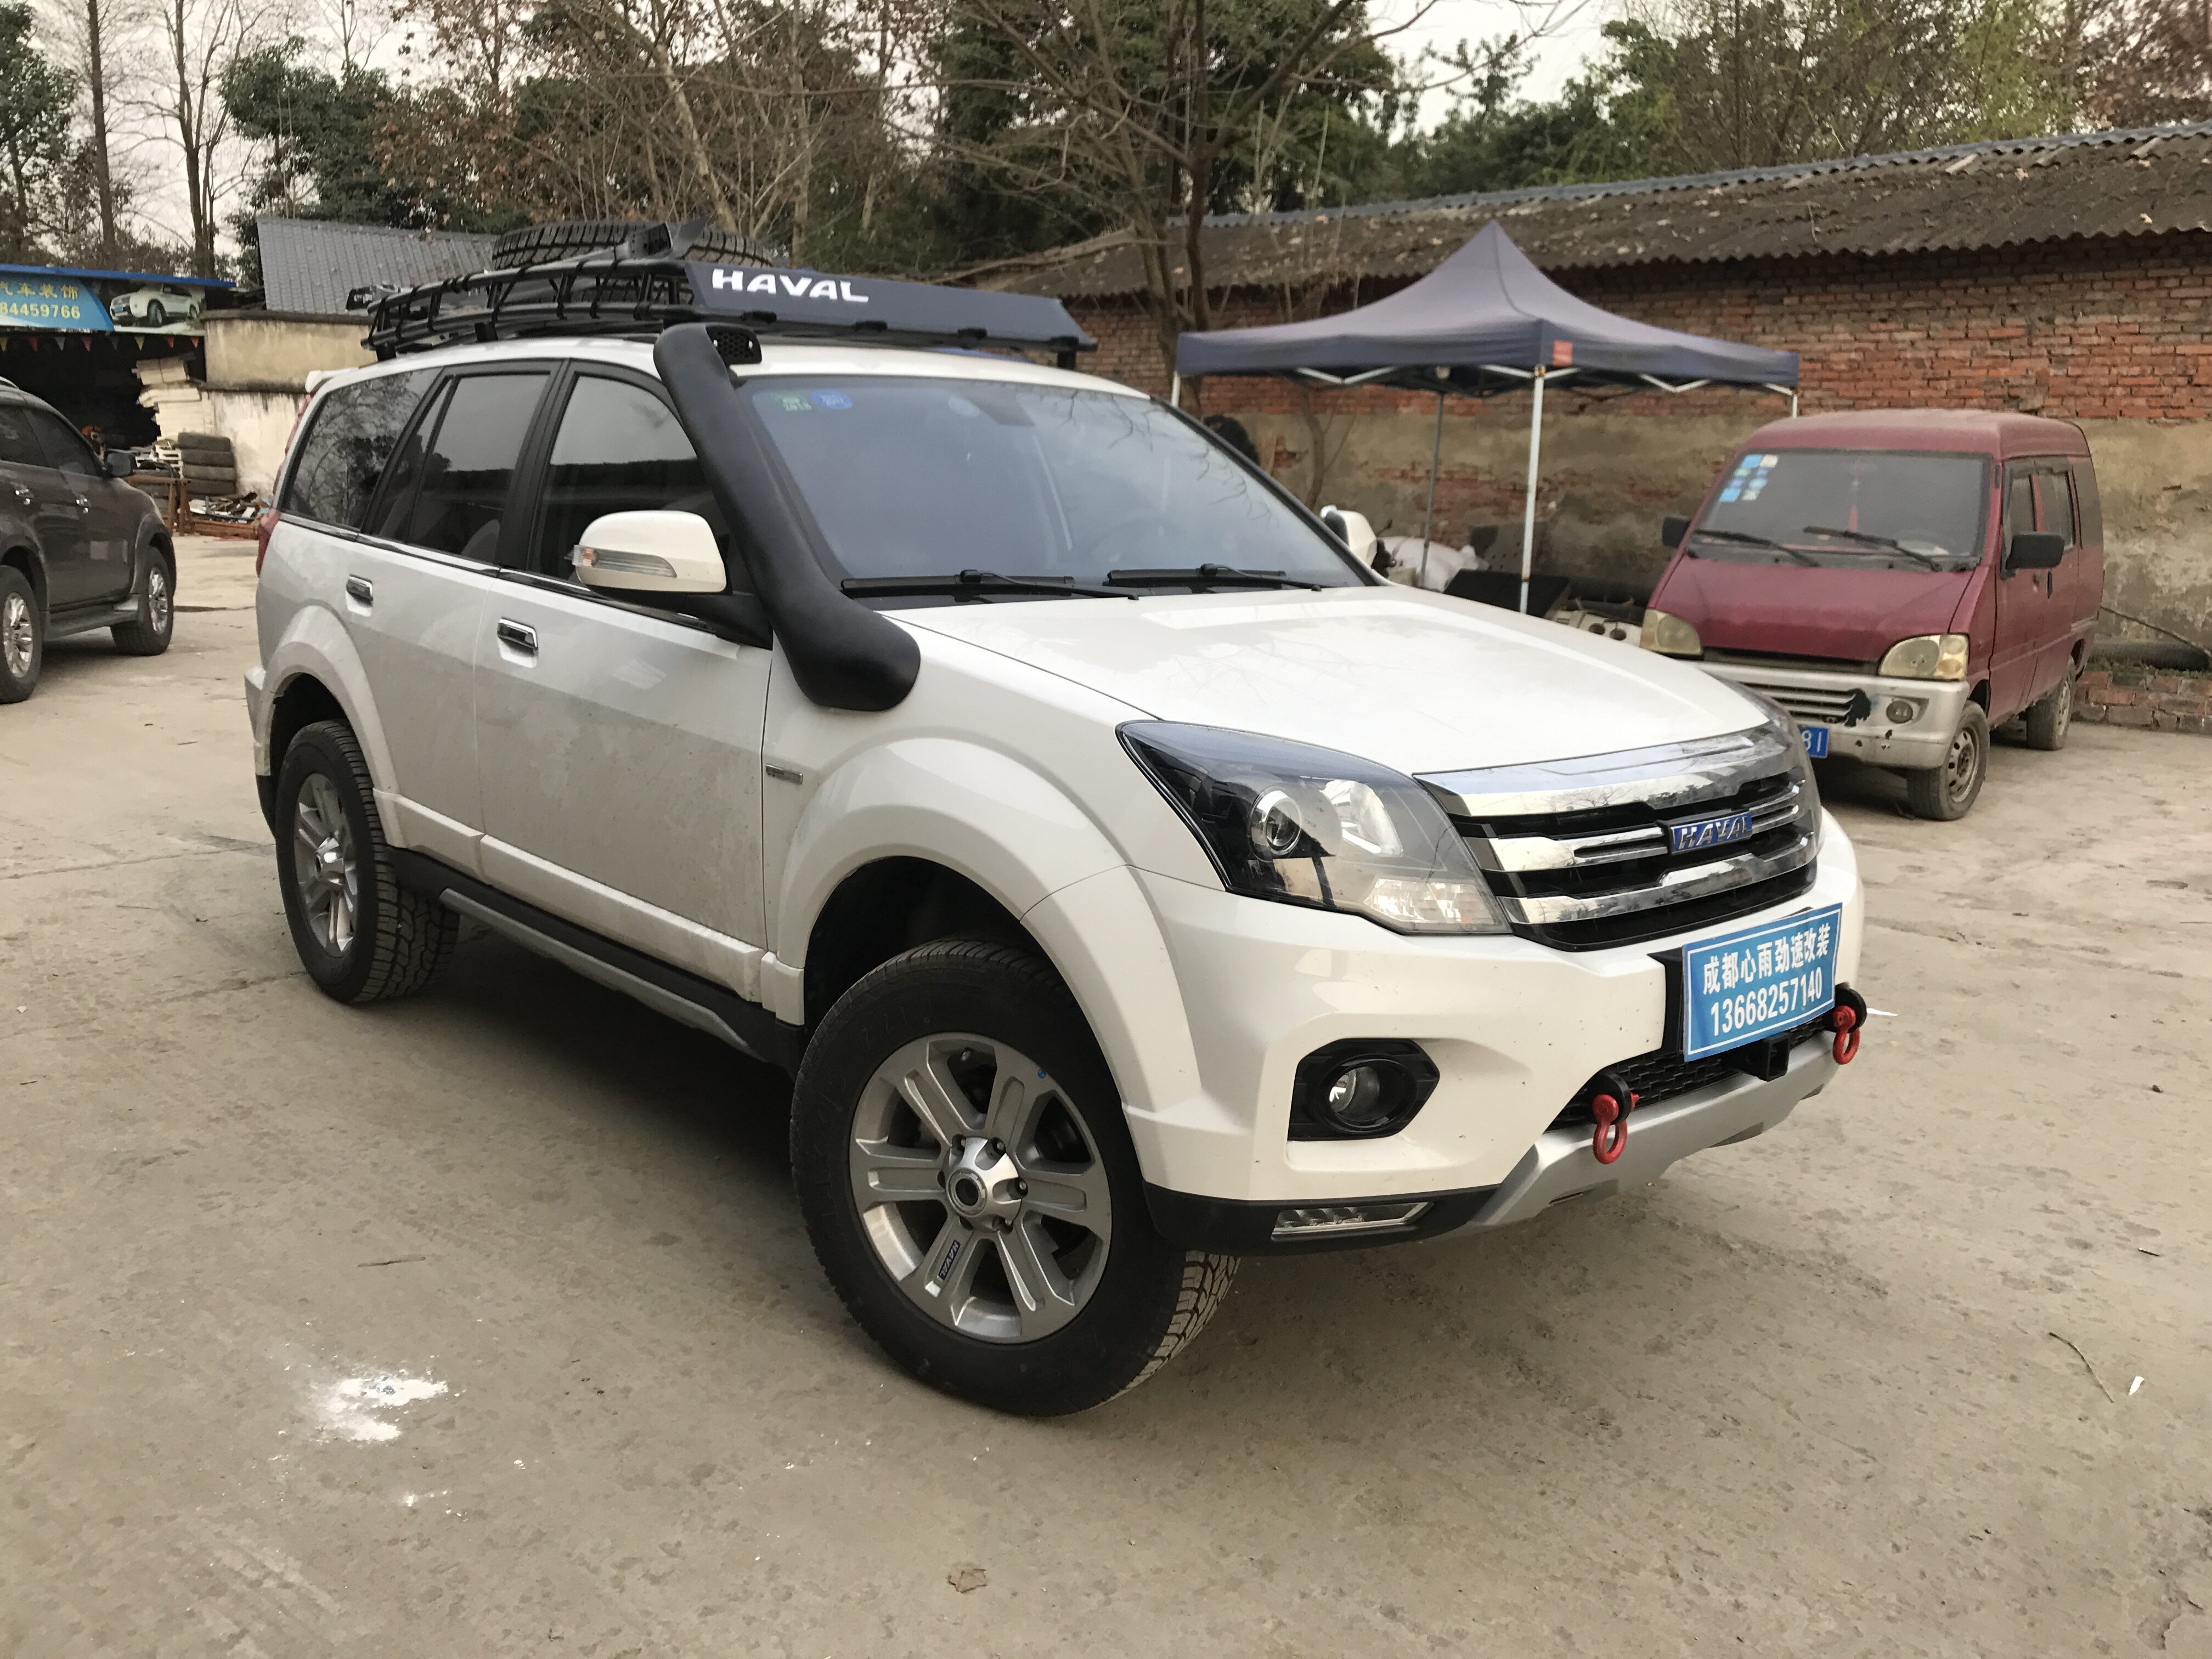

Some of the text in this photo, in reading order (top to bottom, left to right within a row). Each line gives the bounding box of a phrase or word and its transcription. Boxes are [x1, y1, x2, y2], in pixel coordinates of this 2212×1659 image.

[712, 268, 869, 302] HAVAL
[0, 301, 81, 319] 84459766
[1679, 816, 1752, 850] HAVAL
[1703, 923, 1830, 995] 成都心雨劲速改装
[1711, 967, 1822, 1036] 13668257140
[939, 1241, 960, 1278] HAVAL
